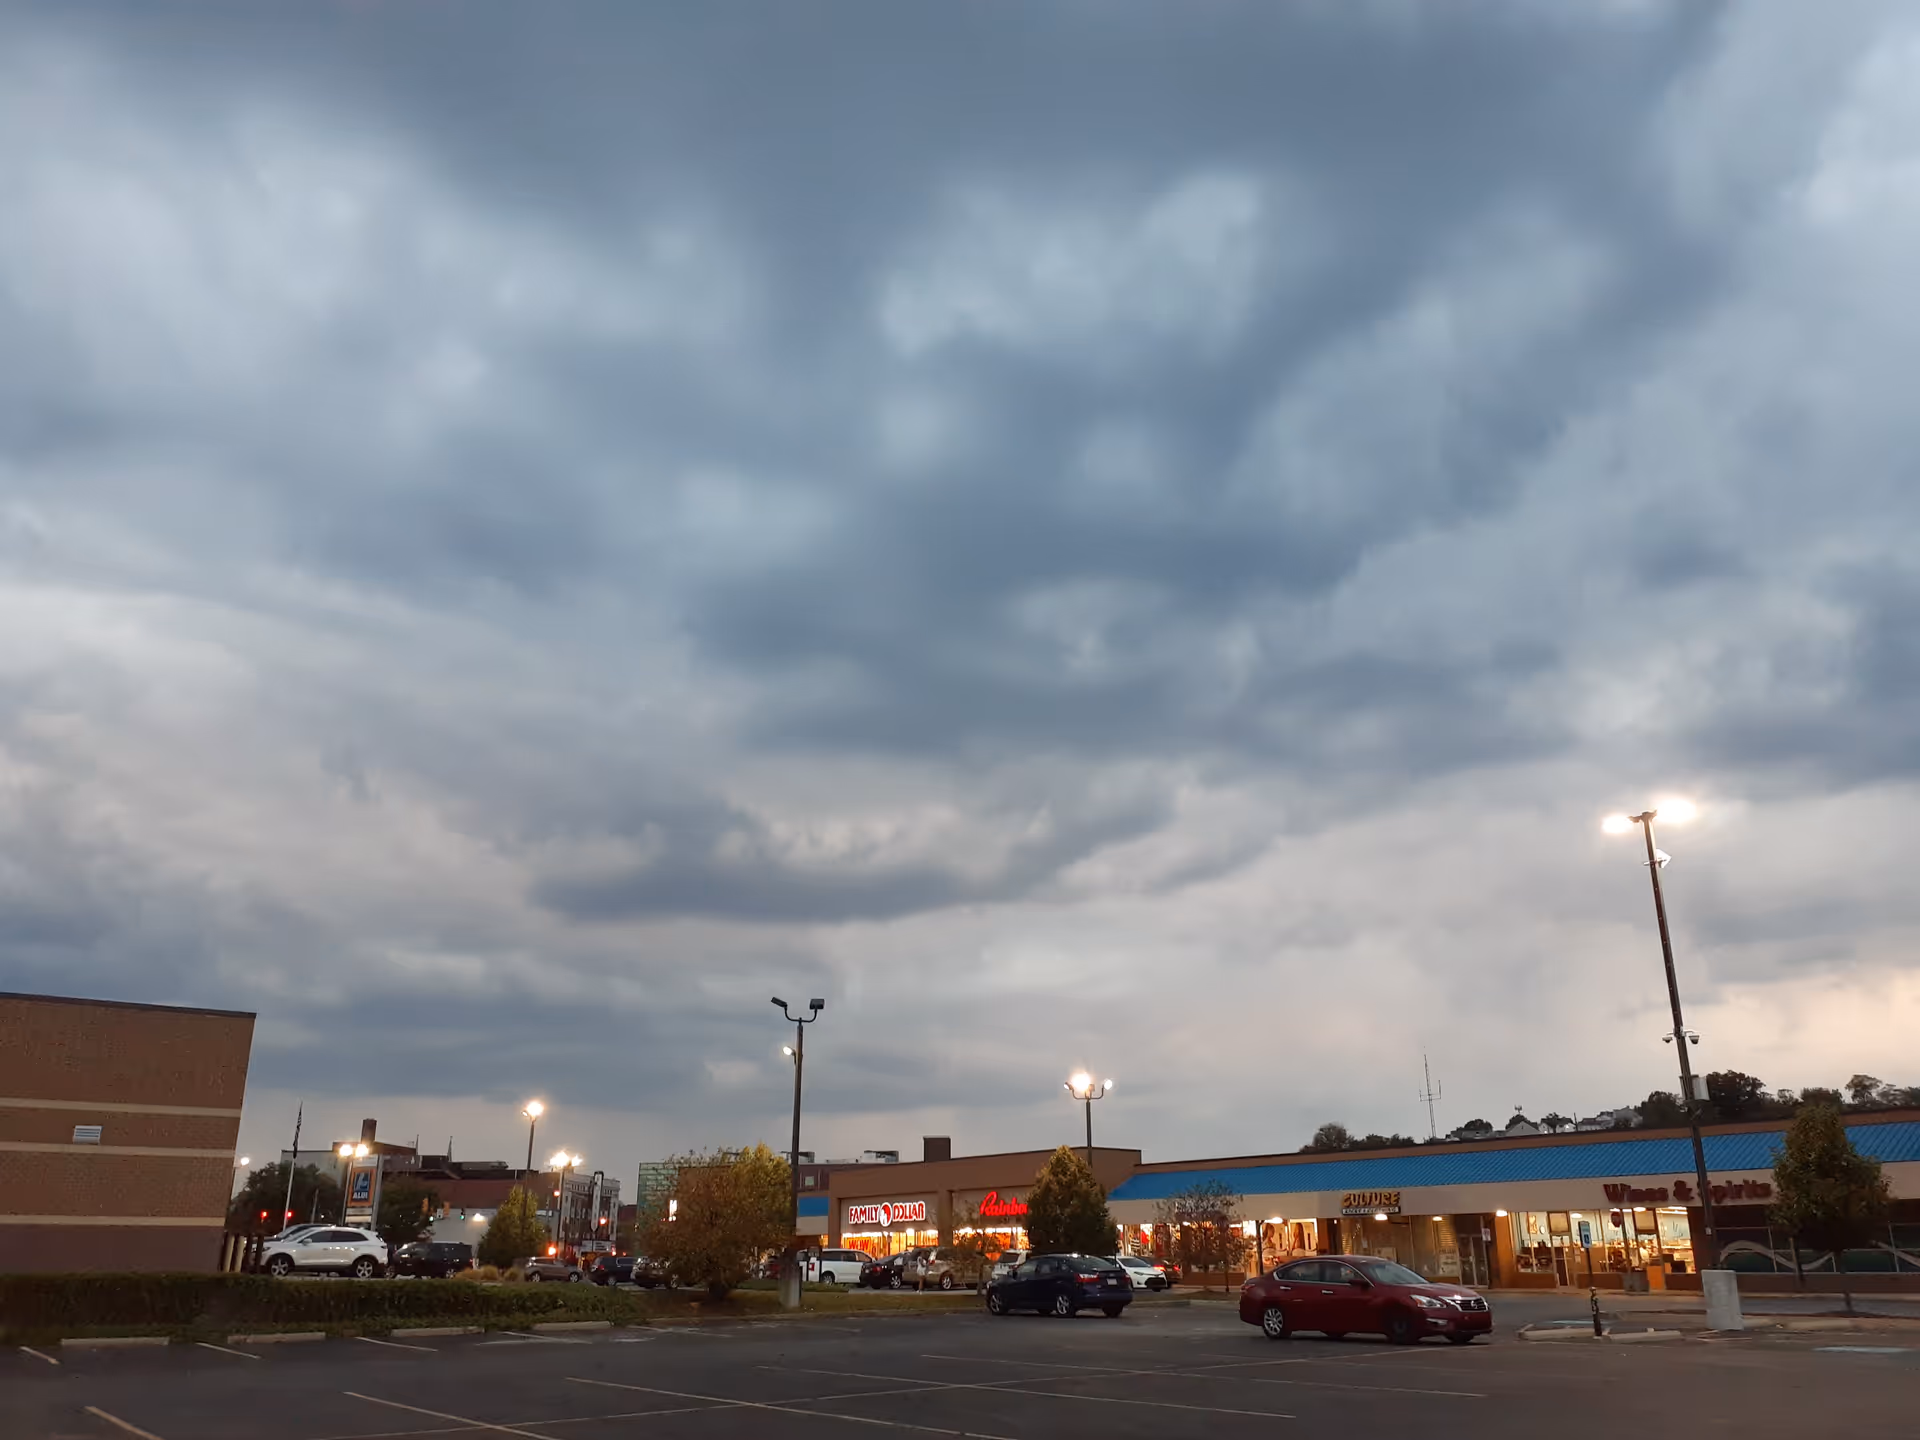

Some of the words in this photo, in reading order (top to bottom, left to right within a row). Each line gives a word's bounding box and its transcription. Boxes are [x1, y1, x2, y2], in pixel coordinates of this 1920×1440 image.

[352, 1191, 369, 1200] ALDI
[1342, 1191, 1400, 1207] CULTURE
[1673, 1180, 1694, 1201] &
[849, 1205, 880, 1224] FAMILY
[892, 1201, 926, 1222] DOLLAR
